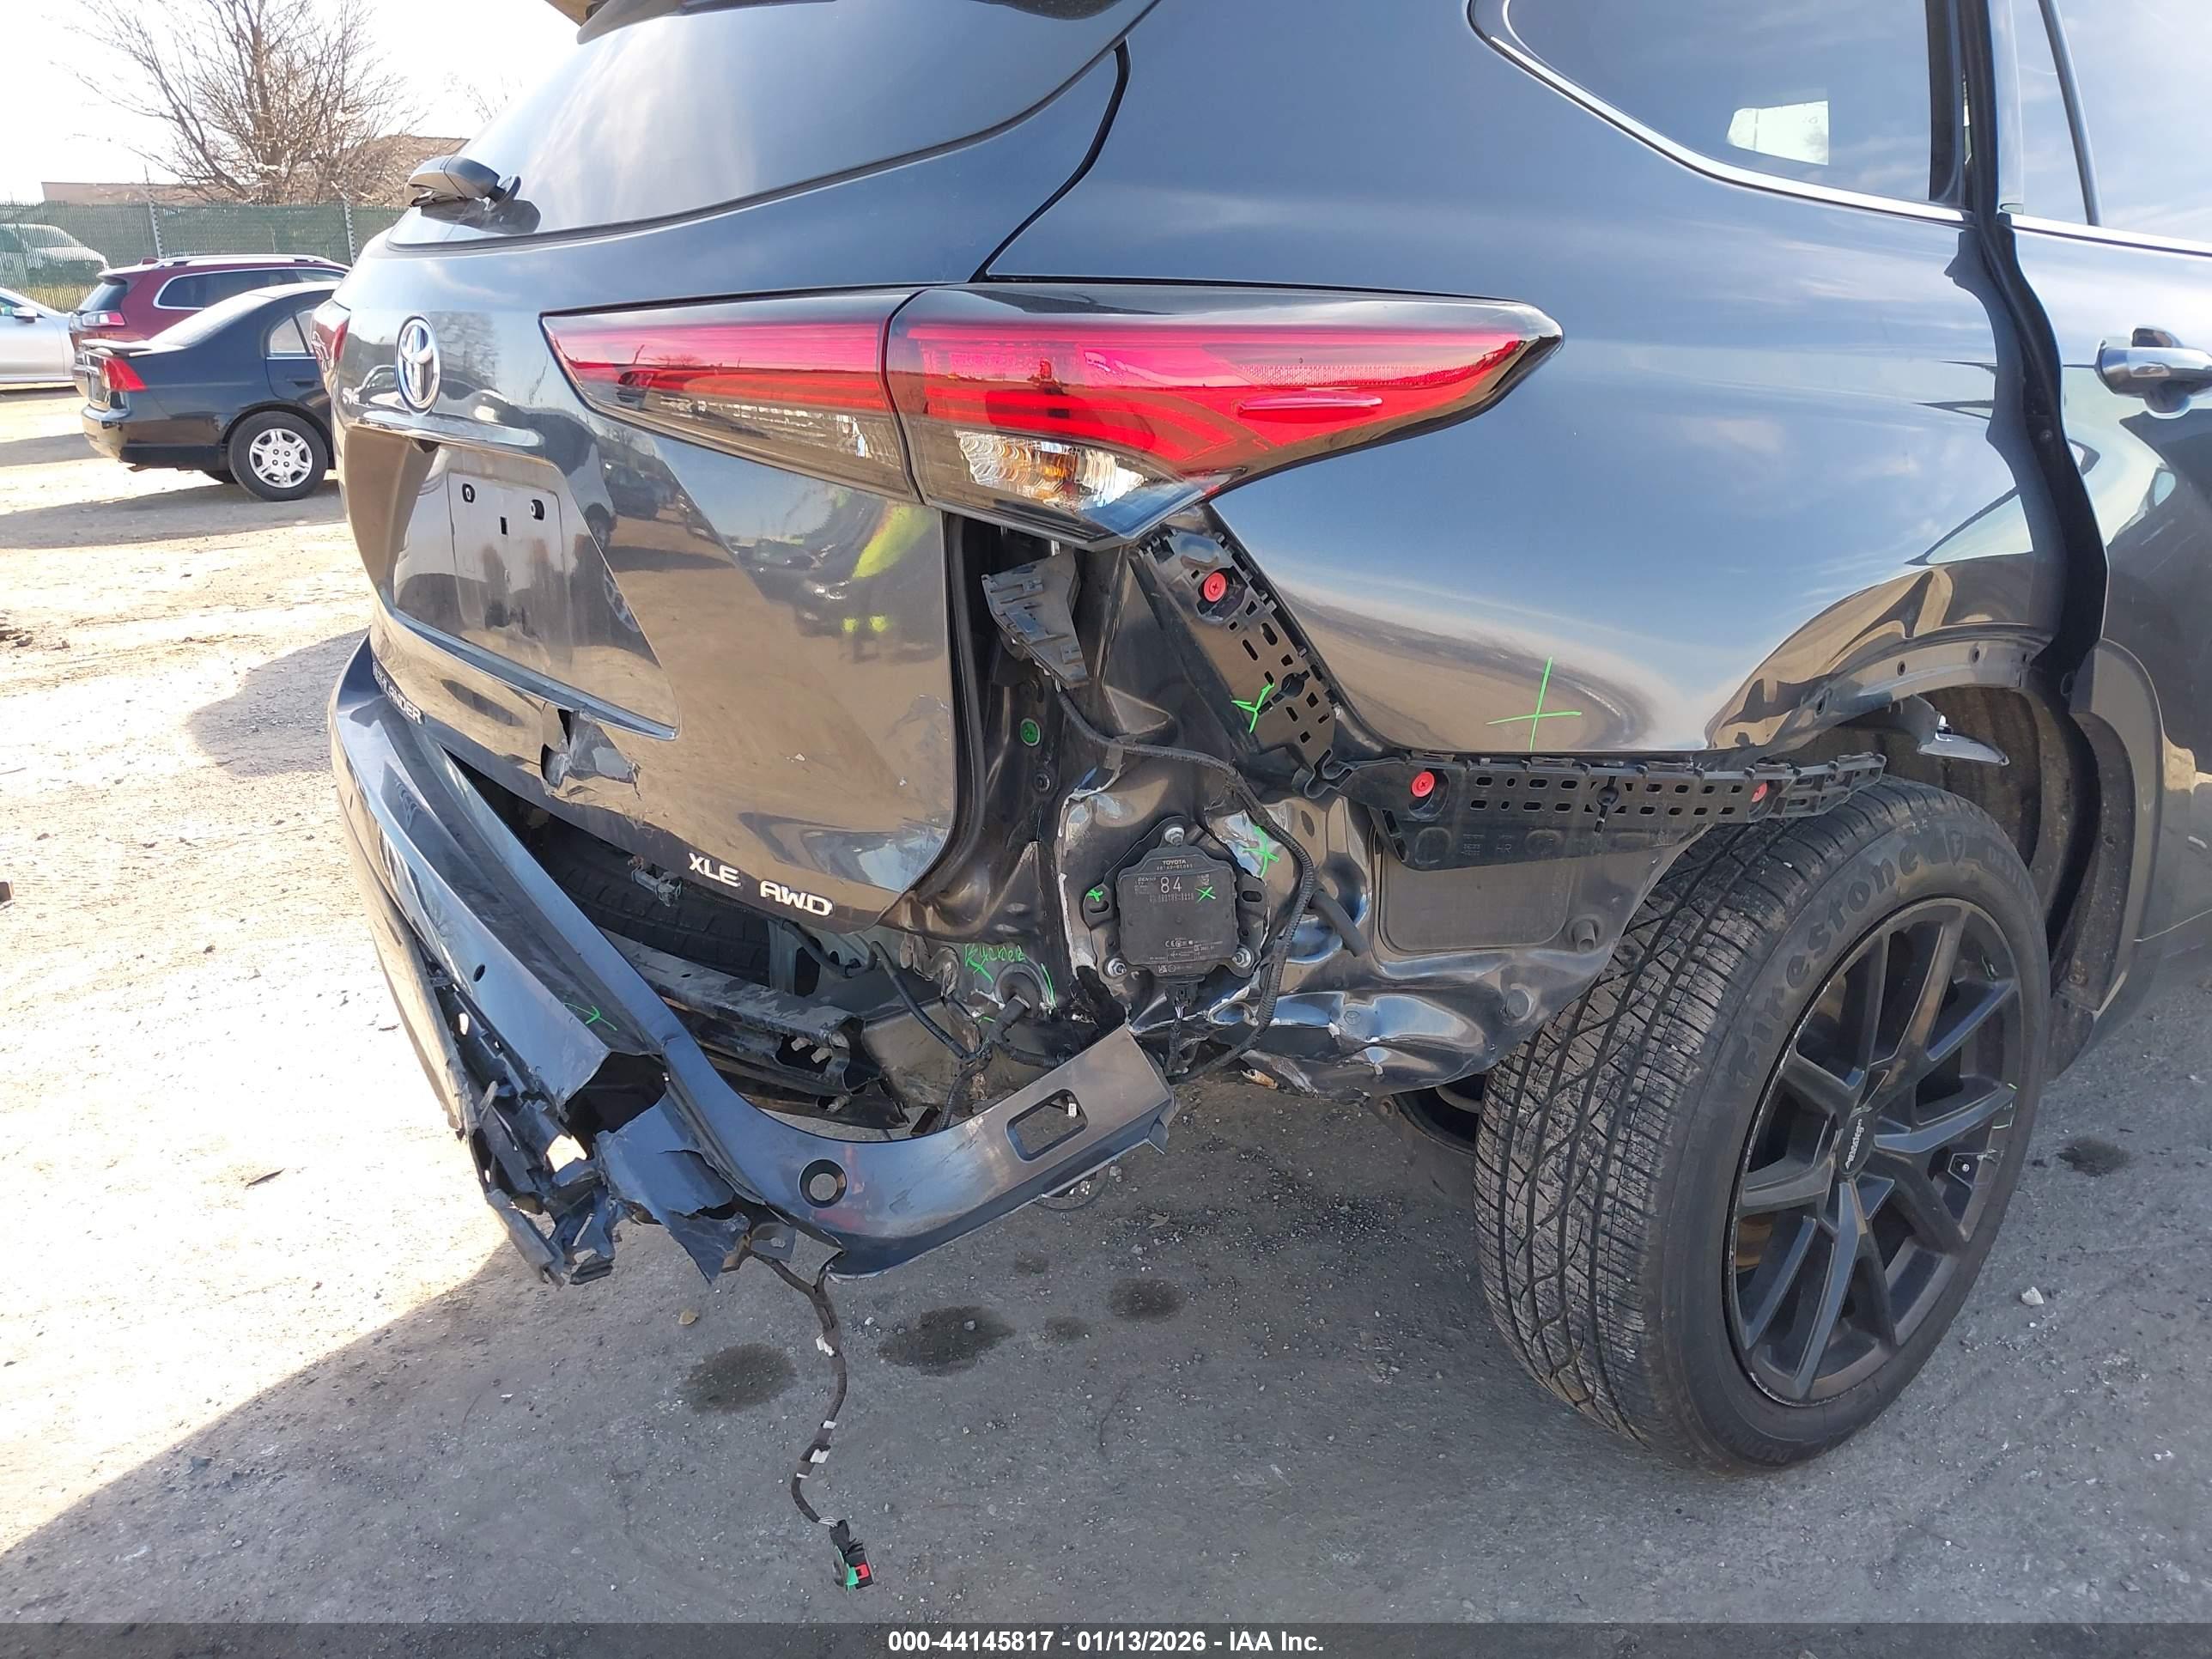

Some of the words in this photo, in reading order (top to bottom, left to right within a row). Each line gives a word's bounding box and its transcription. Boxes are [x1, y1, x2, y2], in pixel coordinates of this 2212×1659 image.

[689, 853, 742, 888] XLE
[760, 880, 833, 913] AWD
[1729, 844, 1920, 1079] Firestone
